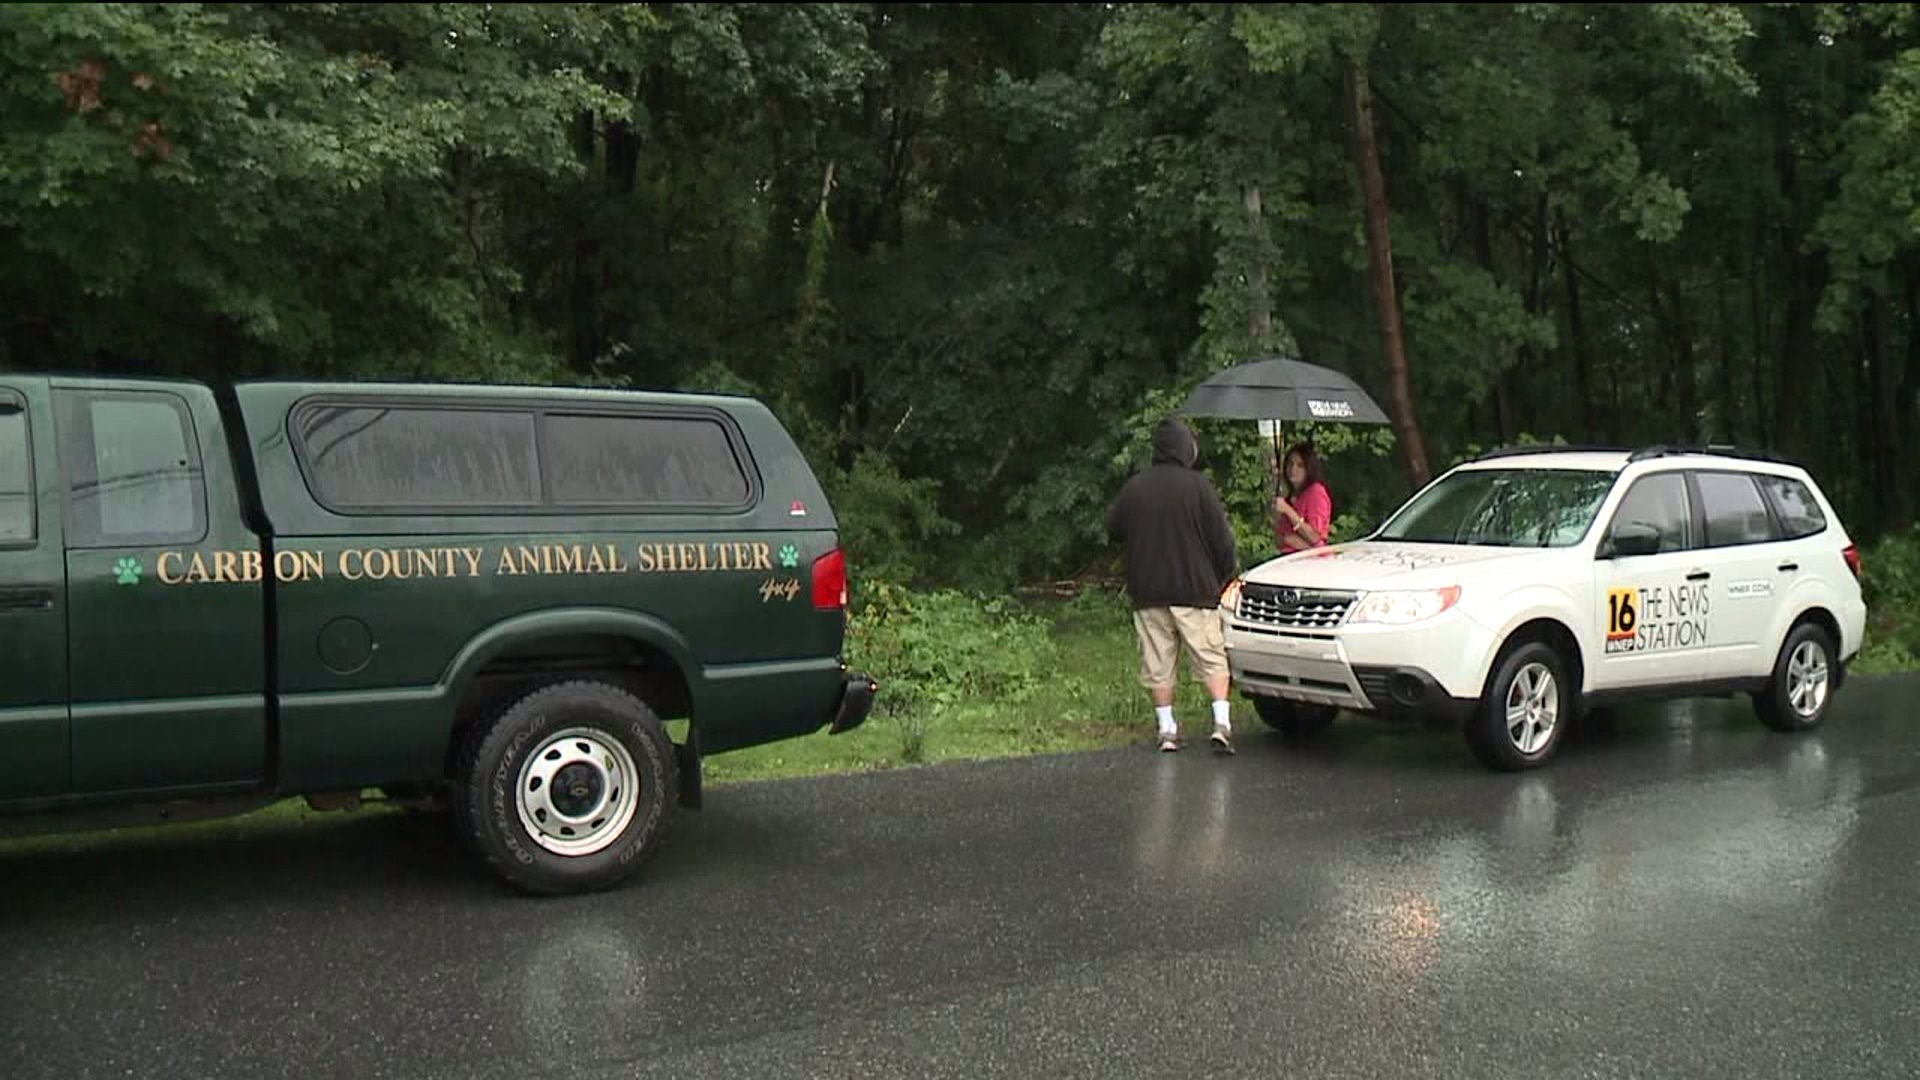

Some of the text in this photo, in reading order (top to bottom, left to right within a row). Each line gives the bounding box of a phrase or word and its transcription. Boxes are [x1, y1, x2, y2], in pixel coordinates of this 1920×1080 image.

[339, 548, 483, 580] COUNTY
[497, 543, 627, 575] ANIMAL
[638, 542, 773, 571] SHELTER
[1609, 594, 1636, 632] 16
[1639, 584, 1710, 619] THE NEWS
[1637, 620, 1707, 650] STATION
